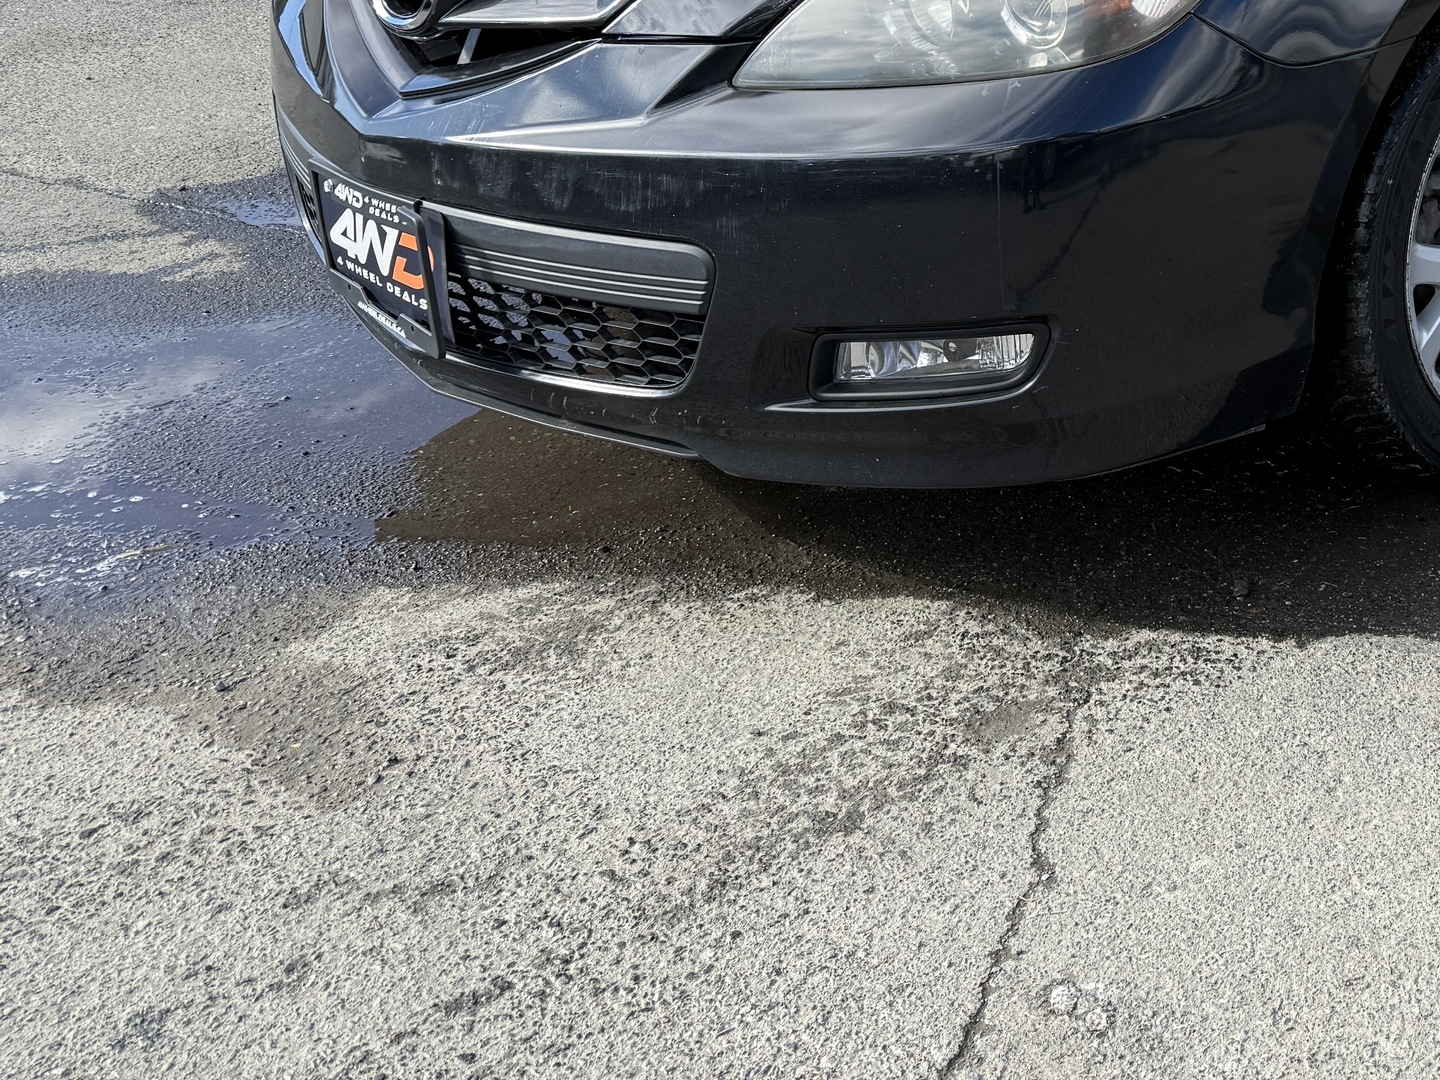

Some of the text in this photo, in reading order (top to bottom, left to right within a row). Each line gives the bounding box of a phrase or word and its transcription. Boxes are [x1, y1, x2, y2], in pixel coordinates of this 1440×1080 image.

[334, 182, 363, 209] 4WD
[371, 198, 400, 214] WHEE
[368, 207, 400, 224] DEALS
[329, 208, 435, 290] 4WD
[336, 255, 429, 311] 4 WHEEL DEALS
